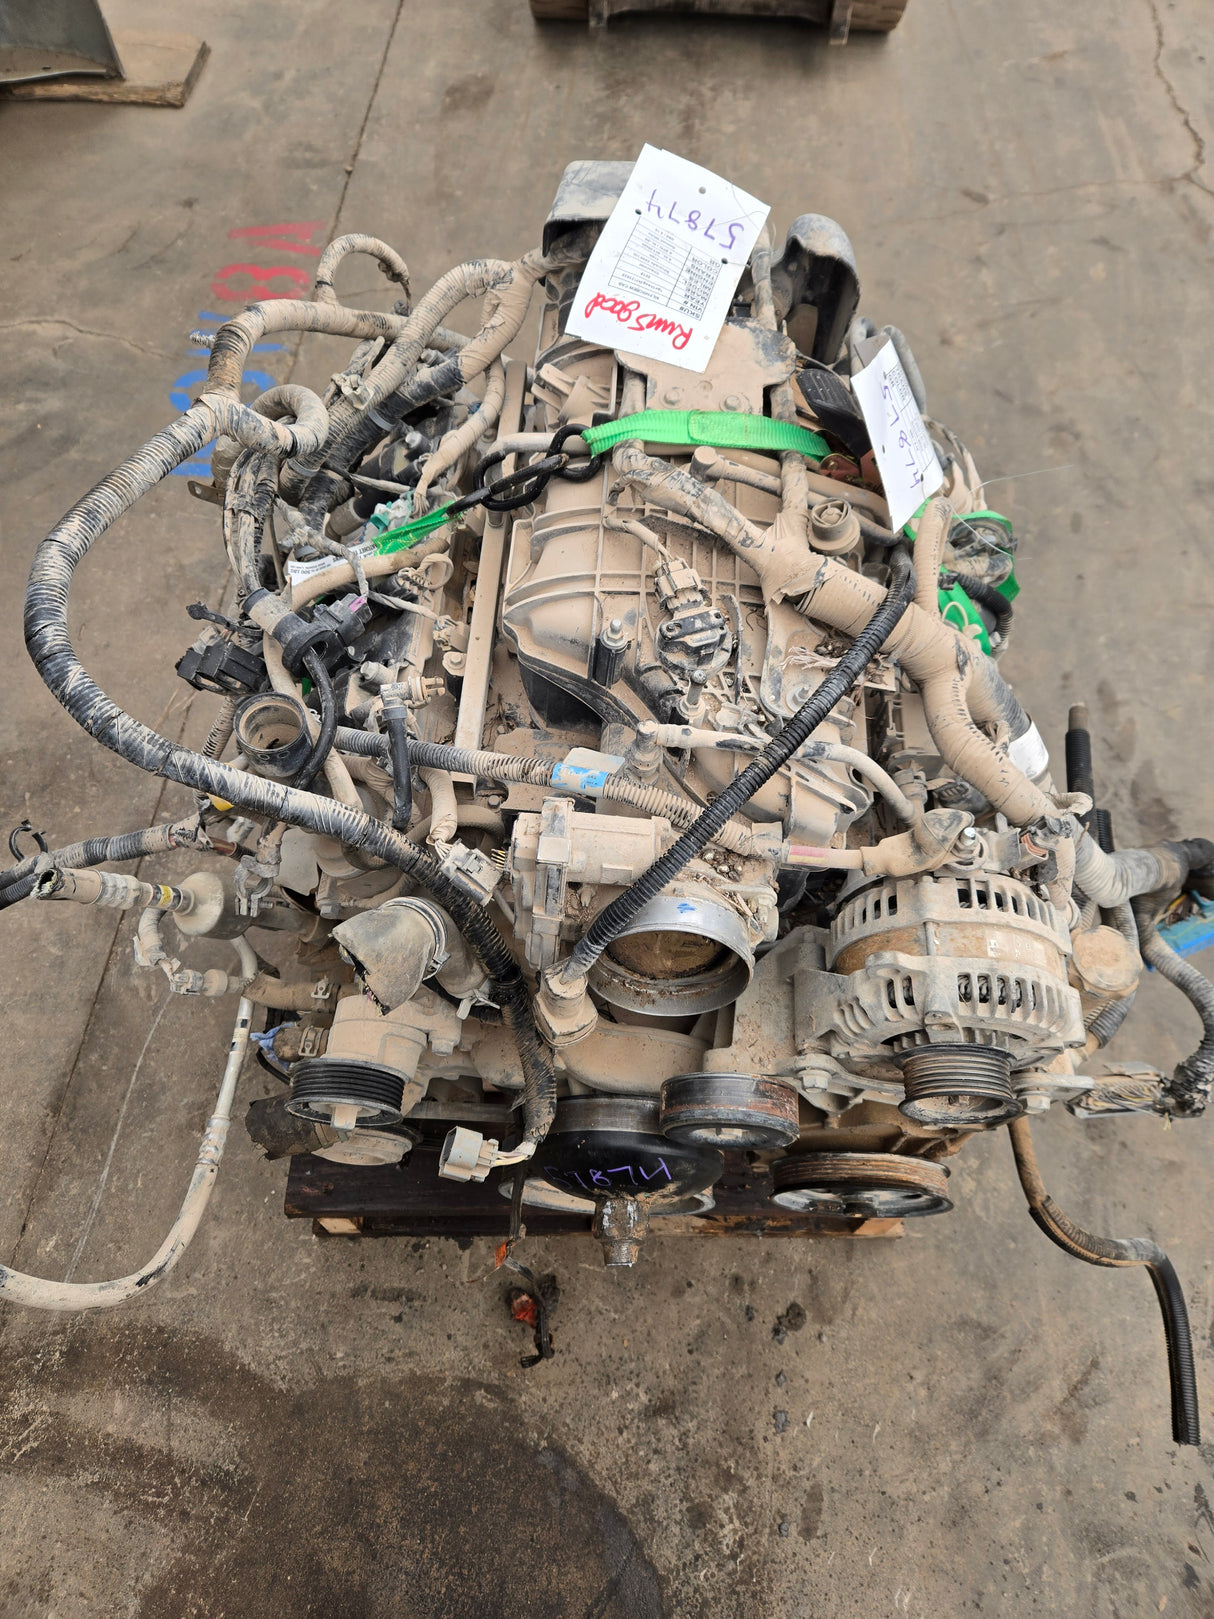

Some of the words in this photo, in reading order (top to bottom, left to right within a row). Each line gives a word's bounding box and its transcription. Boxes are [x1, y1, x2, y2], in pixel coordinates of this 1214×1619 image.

[645, 189, 745, 250] 57874
[585, 292, 640, 322] good
[682, 292, 705, 306] YEAR
[688, 302, 703, 312] VIN
[677, 305, 701, 319] SKU#
[880, 381, 921, 489] 57874
